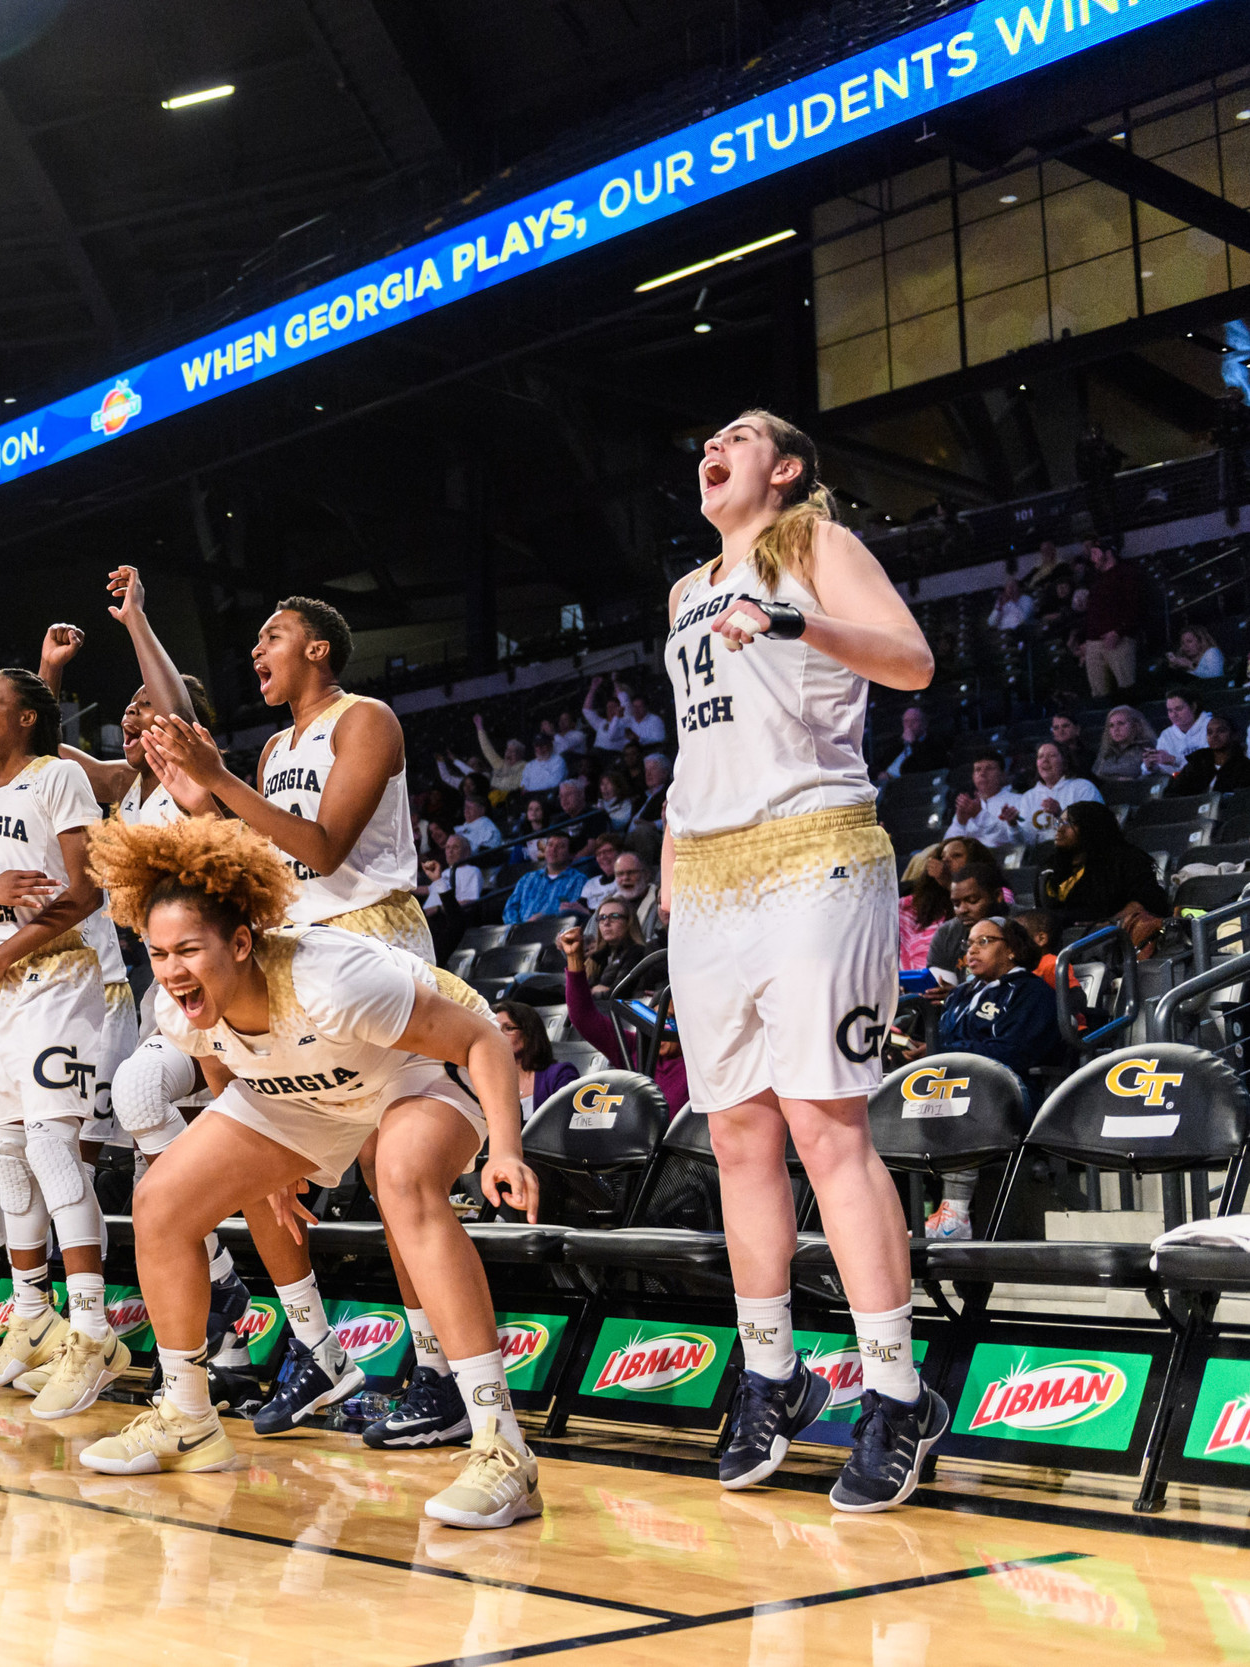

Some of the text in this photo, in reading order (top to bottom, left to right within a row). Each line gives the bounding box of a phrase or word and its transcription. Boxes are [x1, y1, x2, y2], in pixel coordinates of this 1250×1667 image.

[181, 325, 277, 391] WHEN
[284, 258, 442, 350] GEORGIA
[451, 200, 587, 282] PLAYS,
[598, 150, 694, 219] OUR
[709, 31, 978, 174] STUDENTS
[677, 632, 715, 697] 14
[681, 696, 734, 732] ECH
[33, 1046, 97, 1100] GT
[244, 1067, 360, 1096] EORGIA
[1105, 1058, 1184, 1107] GT
[592, 1342, 709, 1392] LIBMAN
[968, 1373, 1117, 1430] LIBMAN
